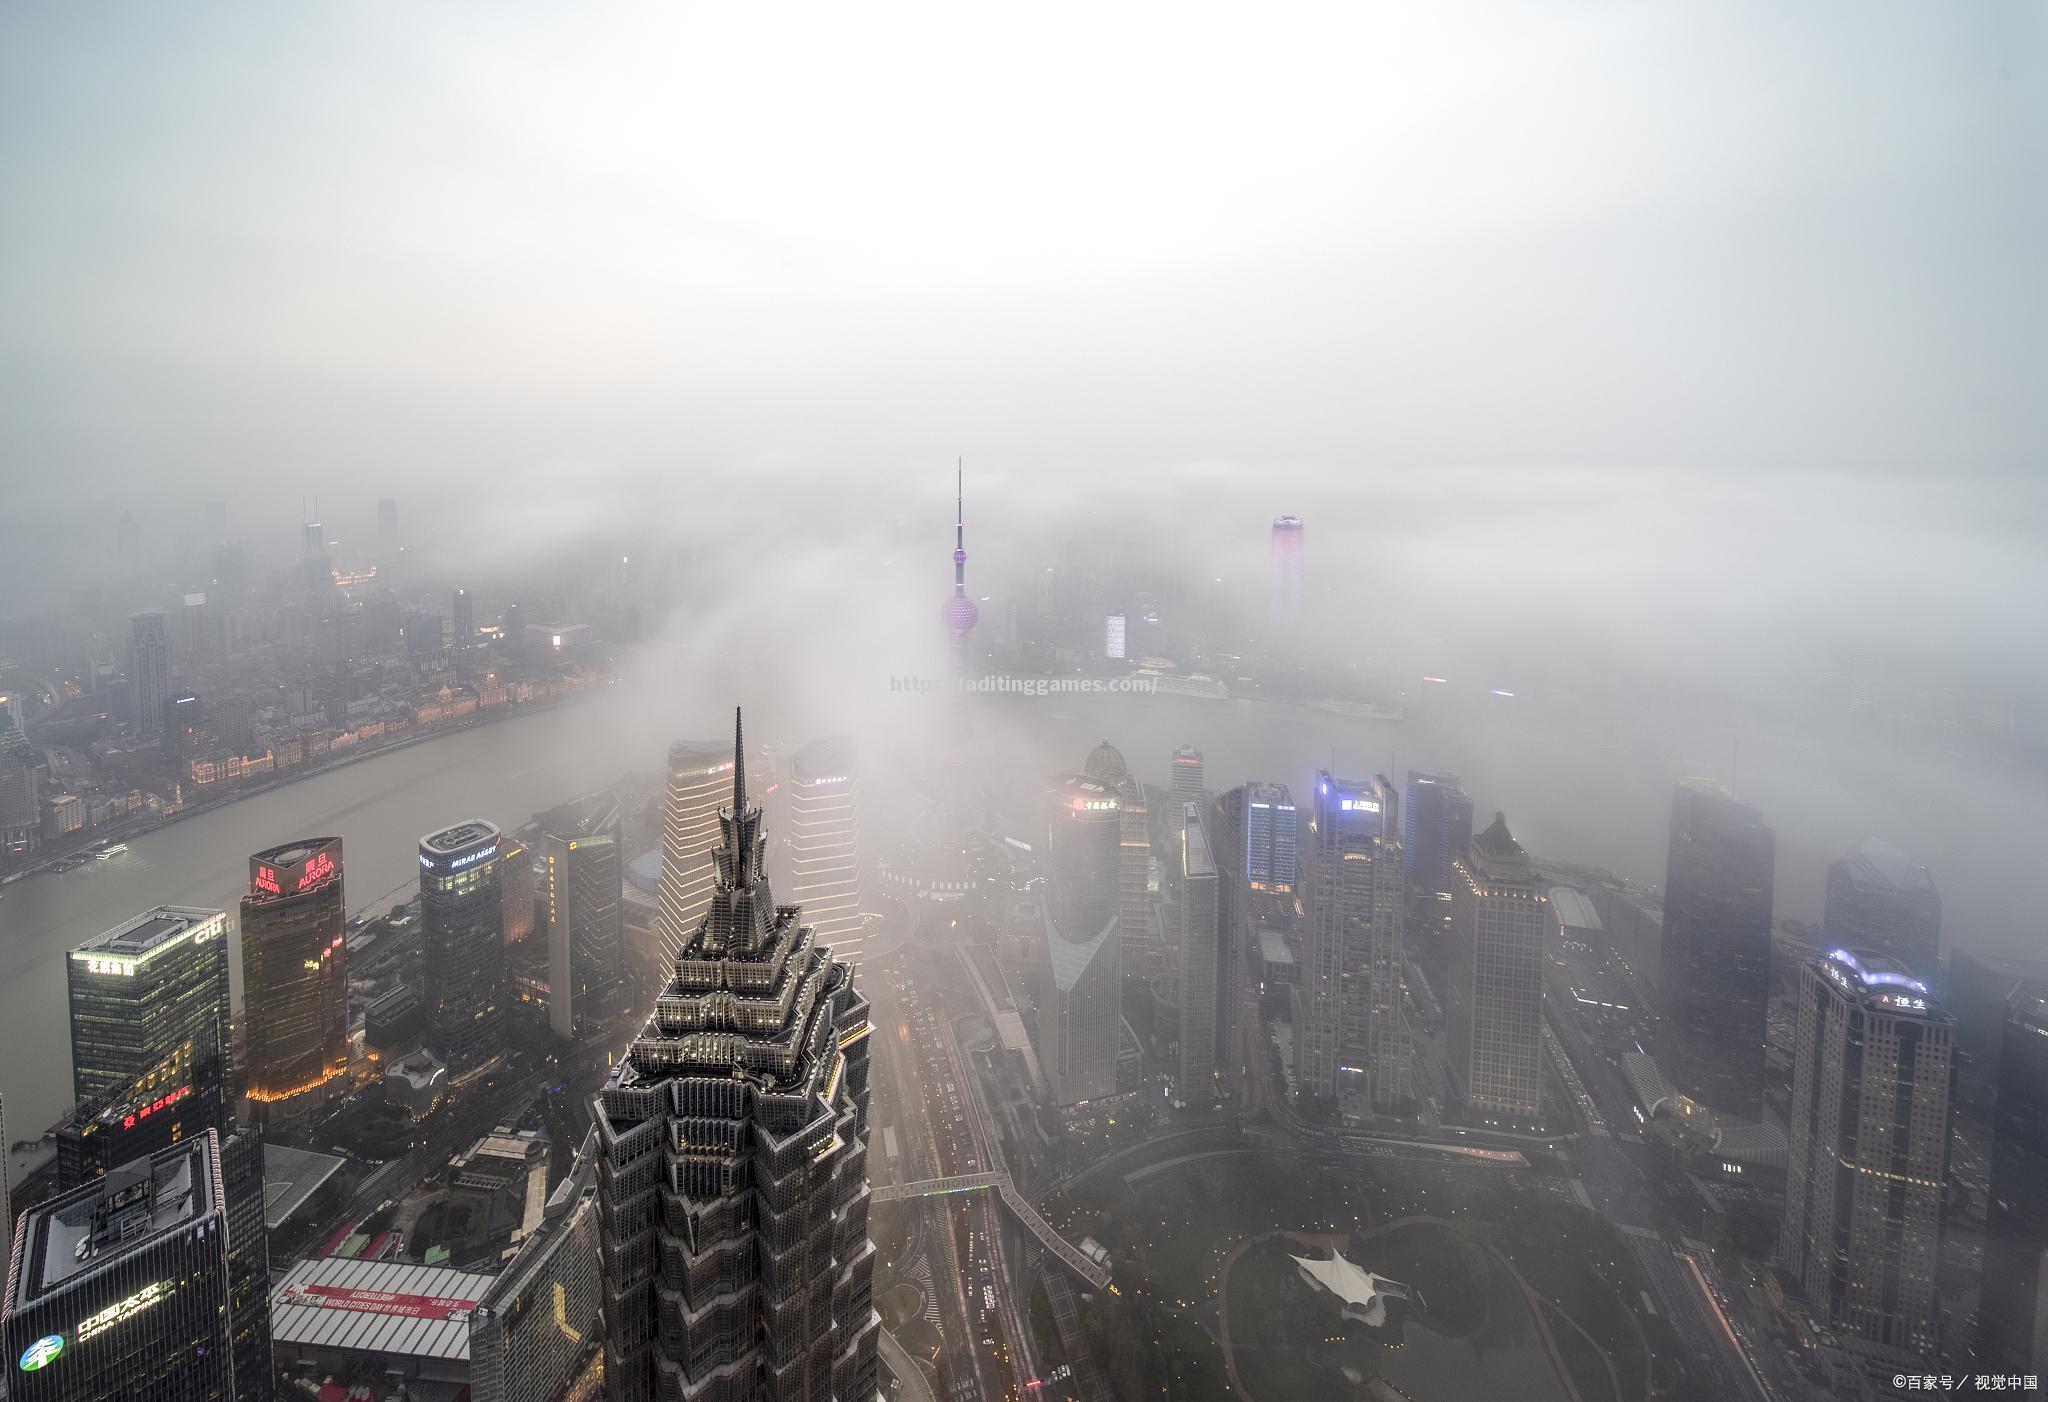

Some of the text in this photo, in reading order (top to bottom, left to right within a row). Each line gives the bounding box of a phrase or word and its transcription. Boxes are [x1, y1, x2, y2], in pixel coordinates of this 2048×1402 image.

[451, 854, 476, 868] MIRAE
[476, 845, 497, 859] ASSET
[256, 877, 280, 894] AURORA
[298, 861, 334, 889] AURORA
[194, 920, 222, 943] citi
[1830, 966, 1848, 989] 恒生
[1894, 995, 1926, 1010] 恒生
[79, 1282, 160, 1334] 中国太平
[324, 1297, 386, 1311] WORLD CITIES DAY
[79, 1295, 160, 1343] CHINA TAIPING
